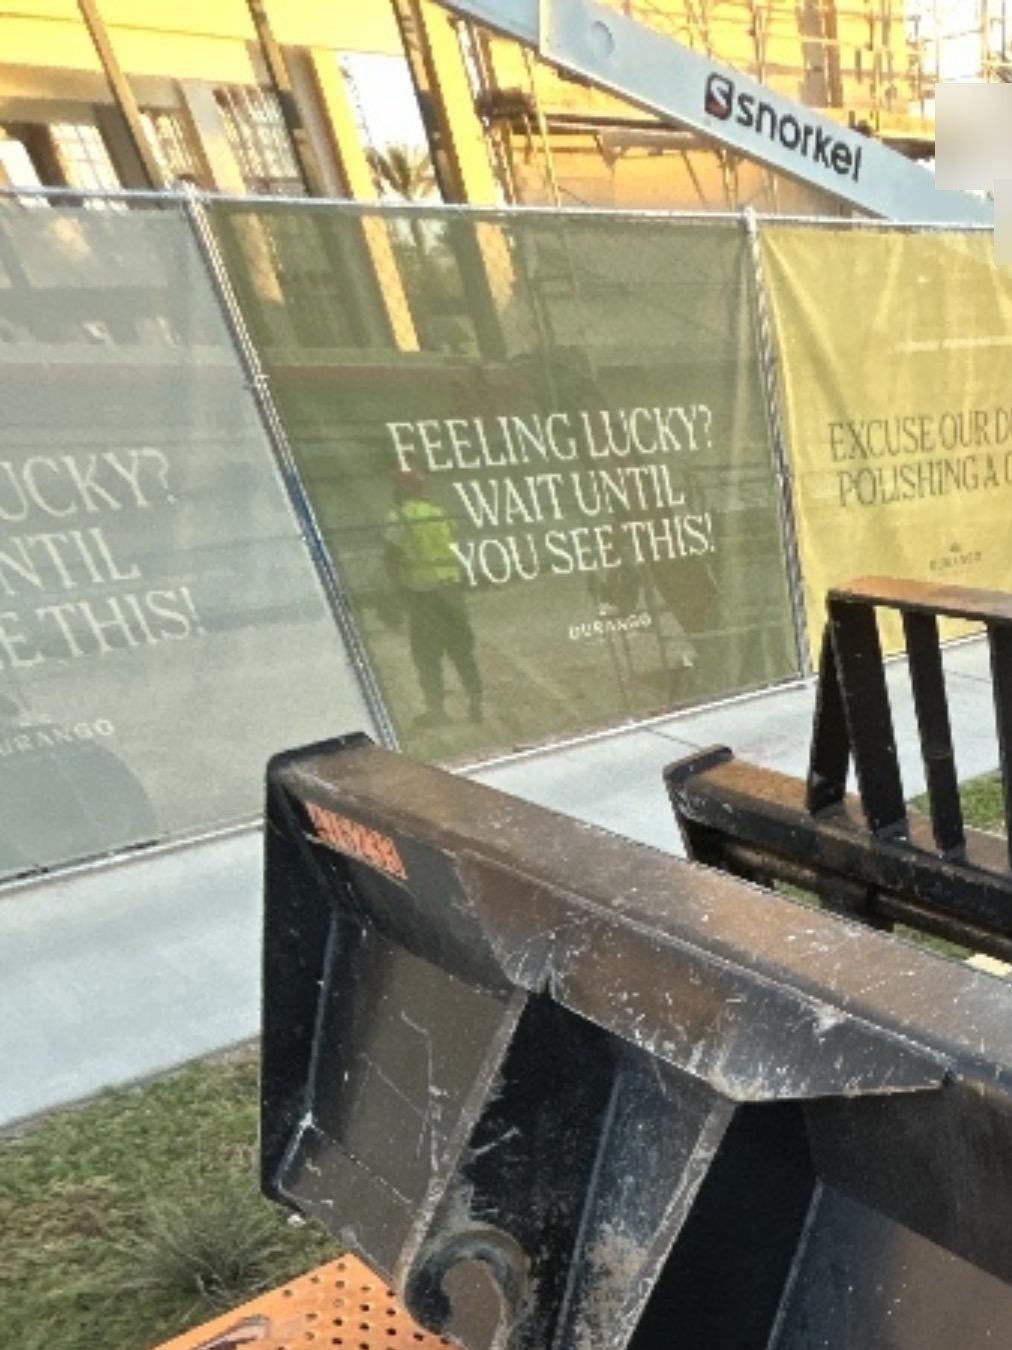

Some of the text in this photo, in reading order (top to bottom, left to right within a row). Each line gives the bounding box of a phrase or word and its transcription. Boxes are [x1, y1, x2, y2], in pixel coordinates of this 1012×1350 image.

[736, 92, 862, 184] snorkel
[386, 404, 713, 472] FEELING LUCKY?
[828, 414, 936, 462] EXCUSE
[939, 410, 991, 450] OUR
[453, 464, 685, 529] WAIT UNTIL
[837, 455, 979, 507] POLISHING
[983, 454, 1000, 489] A
[449, 513, 717, 587] YOU SEE THIS!
[35, 586, 207, 658] THIS!
